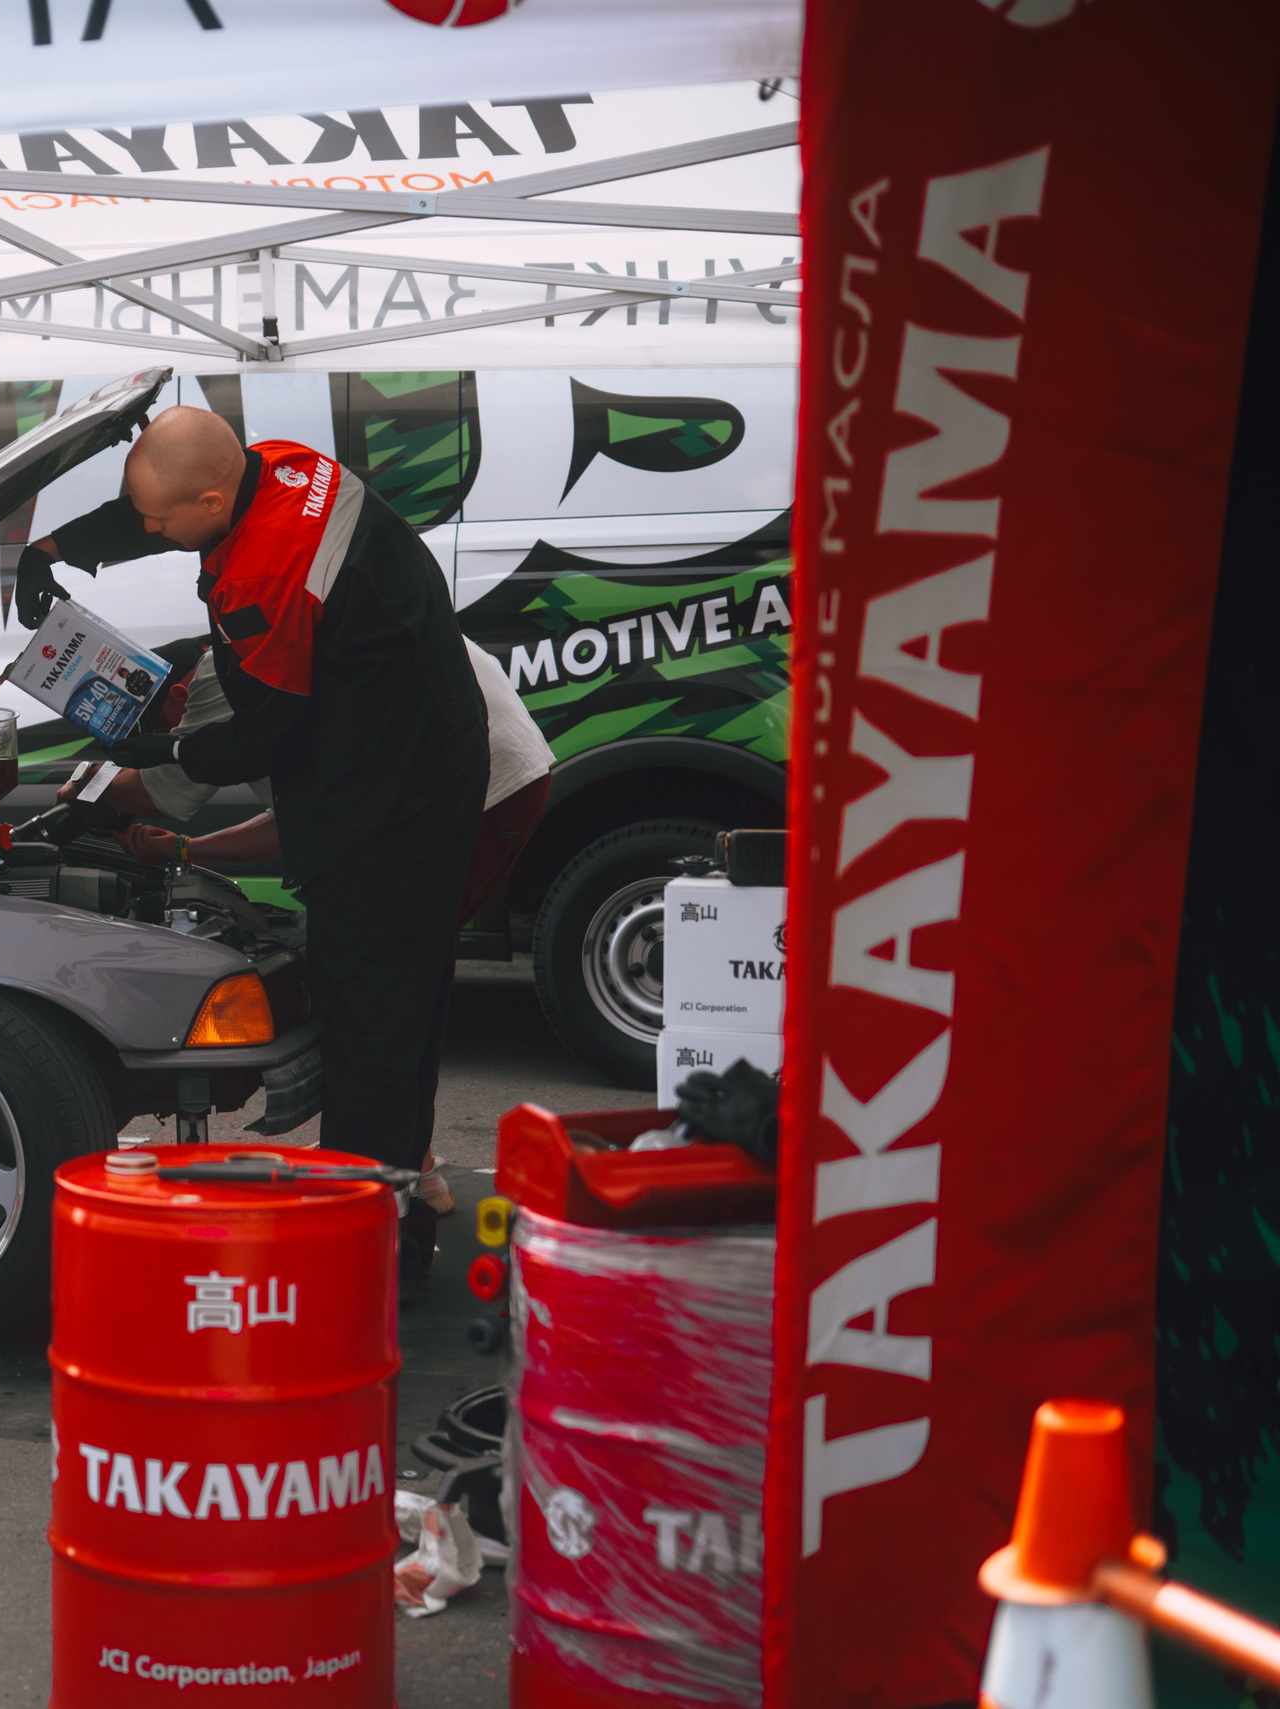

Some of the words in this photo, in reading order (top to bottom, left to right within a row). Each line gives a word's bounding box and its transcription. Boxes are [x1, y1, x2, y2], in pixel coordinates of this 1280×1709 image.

[302, 456, 333, 517] TAKAYAMA
[40, 629, 86, 692] TAKAYAMA
[74, 679, 110, 722] 5W-40
[802, 145, 1051, 1558] TAKAYAMA
[680, 902, 718, 922] 高山
[680, 1002, 694, 1011] JCI
[696, 1002, 748, 1013] Corporation
[676, 1047, 713, 1067] 高山
[183, 1270, 298, 1334] 高山
[78, 1442, 386, 1521] TAKAYAMA
[99, 1647, 130, 1674] JCI
[134, 1654, 295, 1689] Corporation,
[303, 1648, 361, 1681] Japan
